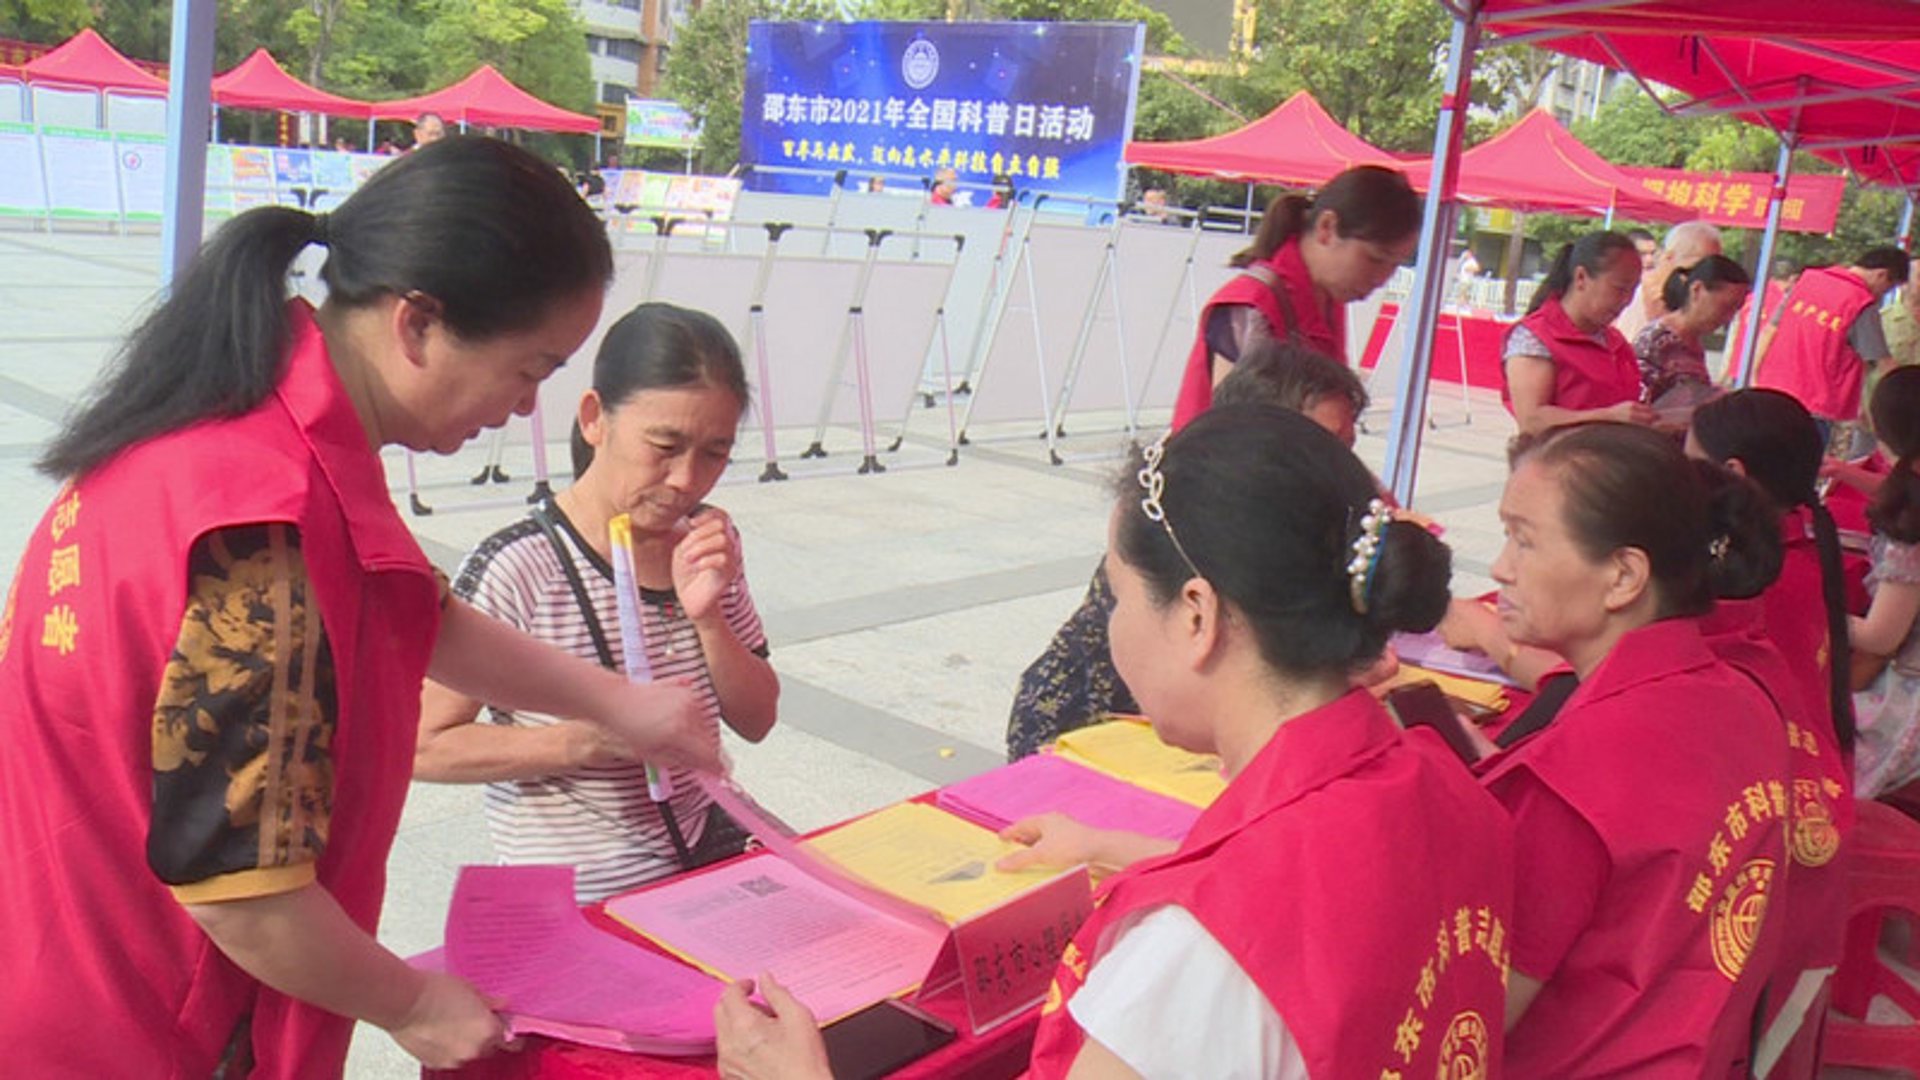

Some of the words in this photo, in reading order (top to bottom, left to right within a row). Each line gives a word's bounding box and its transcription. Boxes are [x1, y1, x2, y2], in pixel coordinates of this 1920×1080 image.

[763, 92, 1095, 140] 邵东市2021年全国科普日活动
[42, 490, 80, 656] 志愿者
